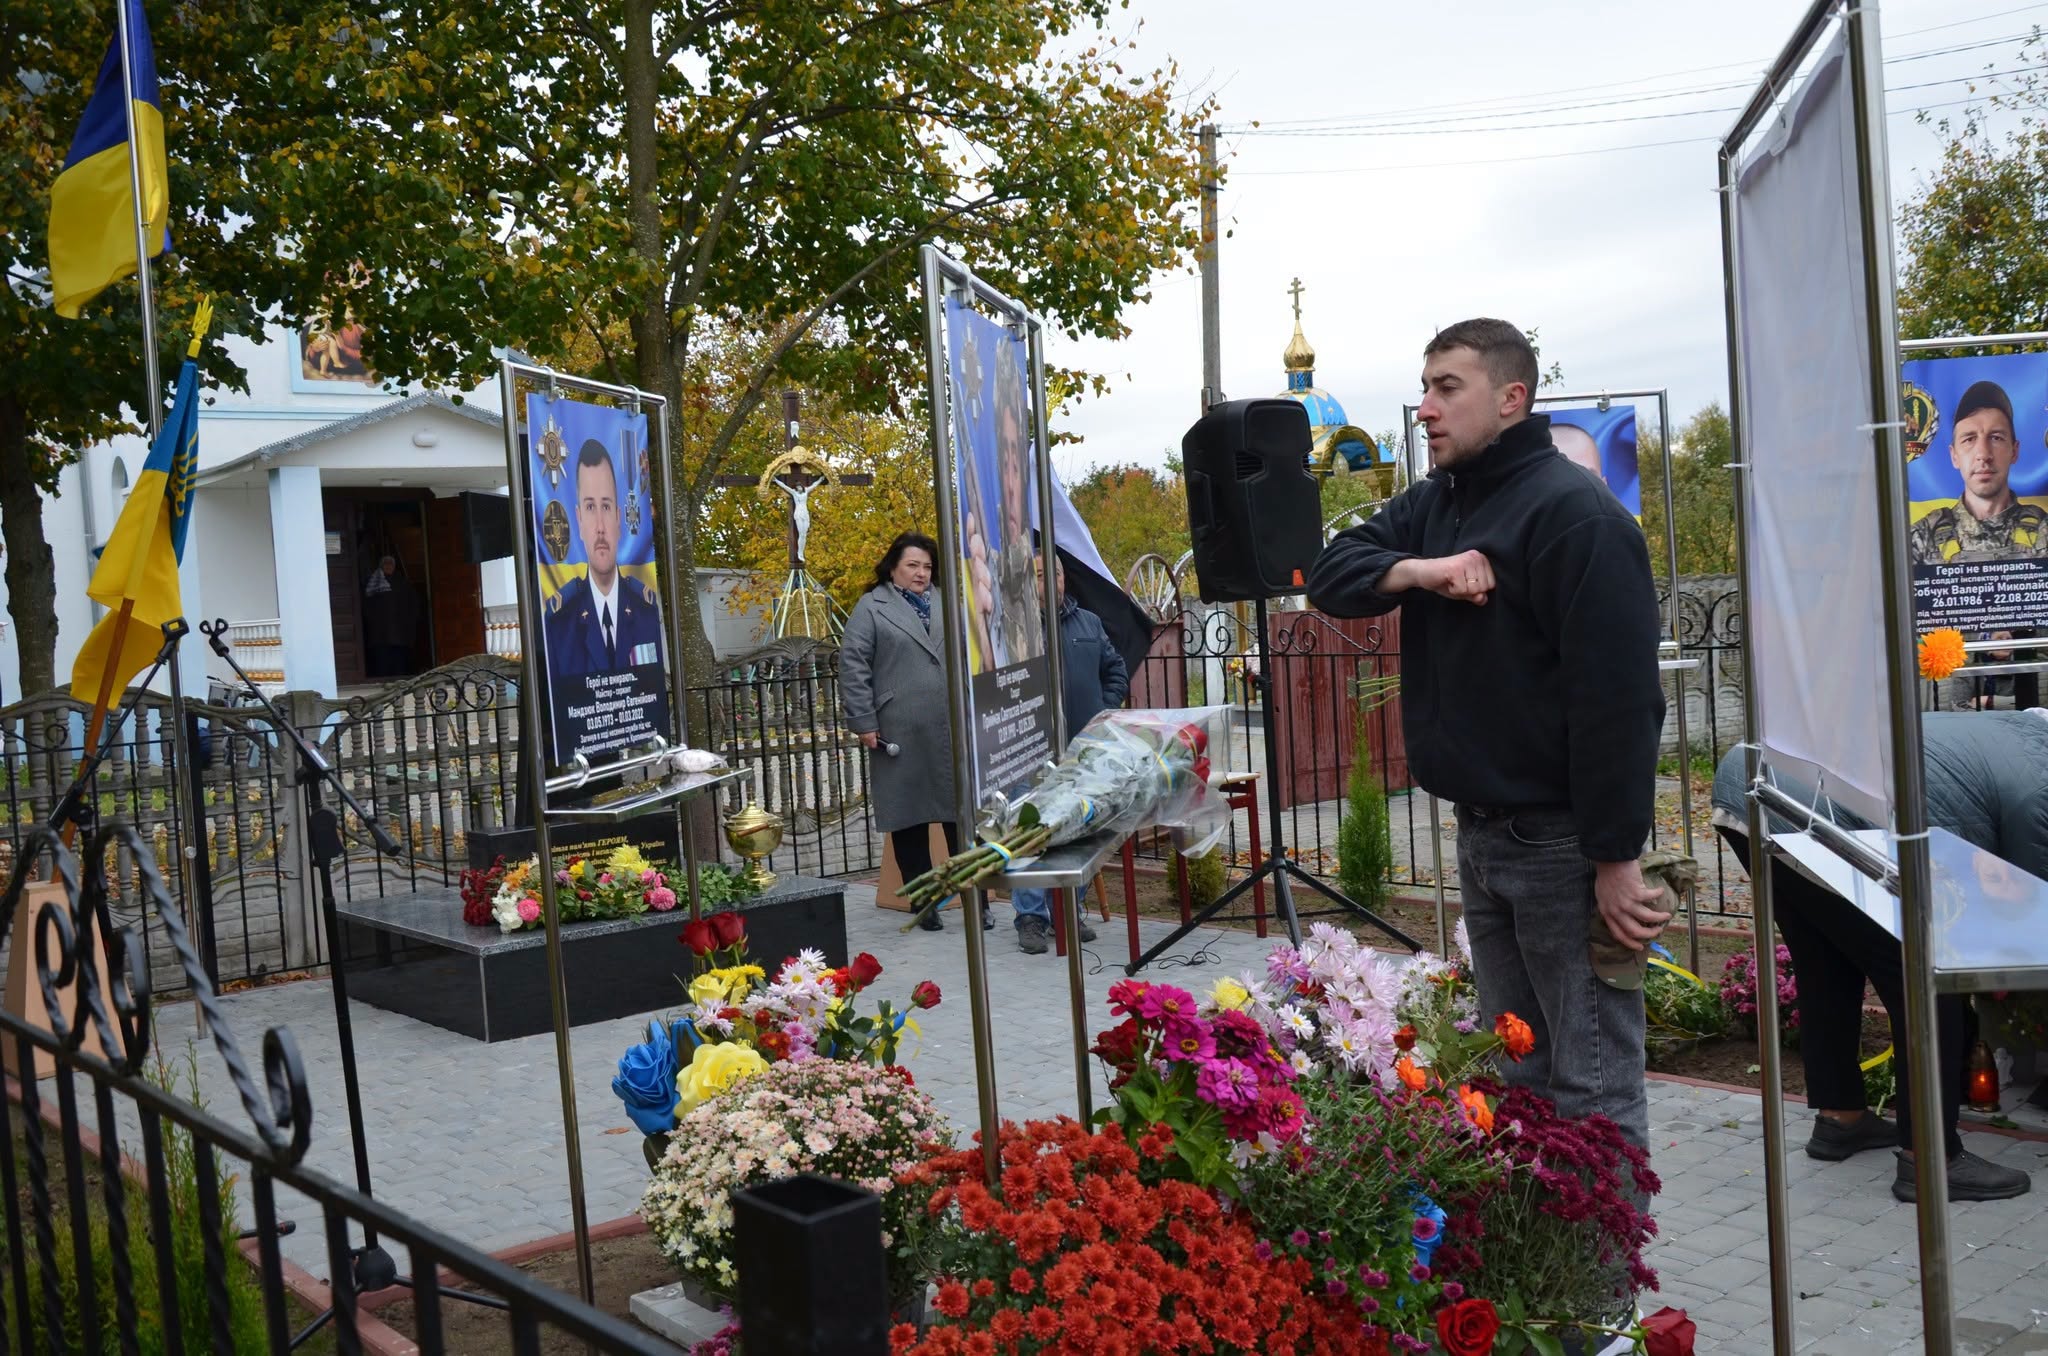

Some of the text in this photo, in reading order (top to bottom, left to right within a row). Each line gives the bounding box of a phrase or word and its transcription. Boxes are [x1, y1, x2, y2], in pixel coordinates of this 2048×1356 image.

[1936, 565, 1965, 577] Герої
[1966, 566, 1980, 574] не
[1931, 577, 1959, 585] солдат
[1960, 575, 1999, 583] інспектор
[1951, 583, 1994, 596] Валерій
[1932, 595, 1983, 608] 26.01.1986
[1993, 591, 2048, 604] 22.08.2025
[1917, 610, 1930, 618] під
[1946, 608, 1986, 616] виконання
[1987, 604, 2021, 613] бойового
[1959, 612, 2015, 623] територіальної
[586, 674, 601, 690] Герої
[601, 676, 609, 686] не
[568, 705, 596, 719] Мандзюк
[595, 699, 626, 715] Володимир
[586, 714, 614, 730] 03.05.1973
[618, 707, 644, 724] 01.03.2022
